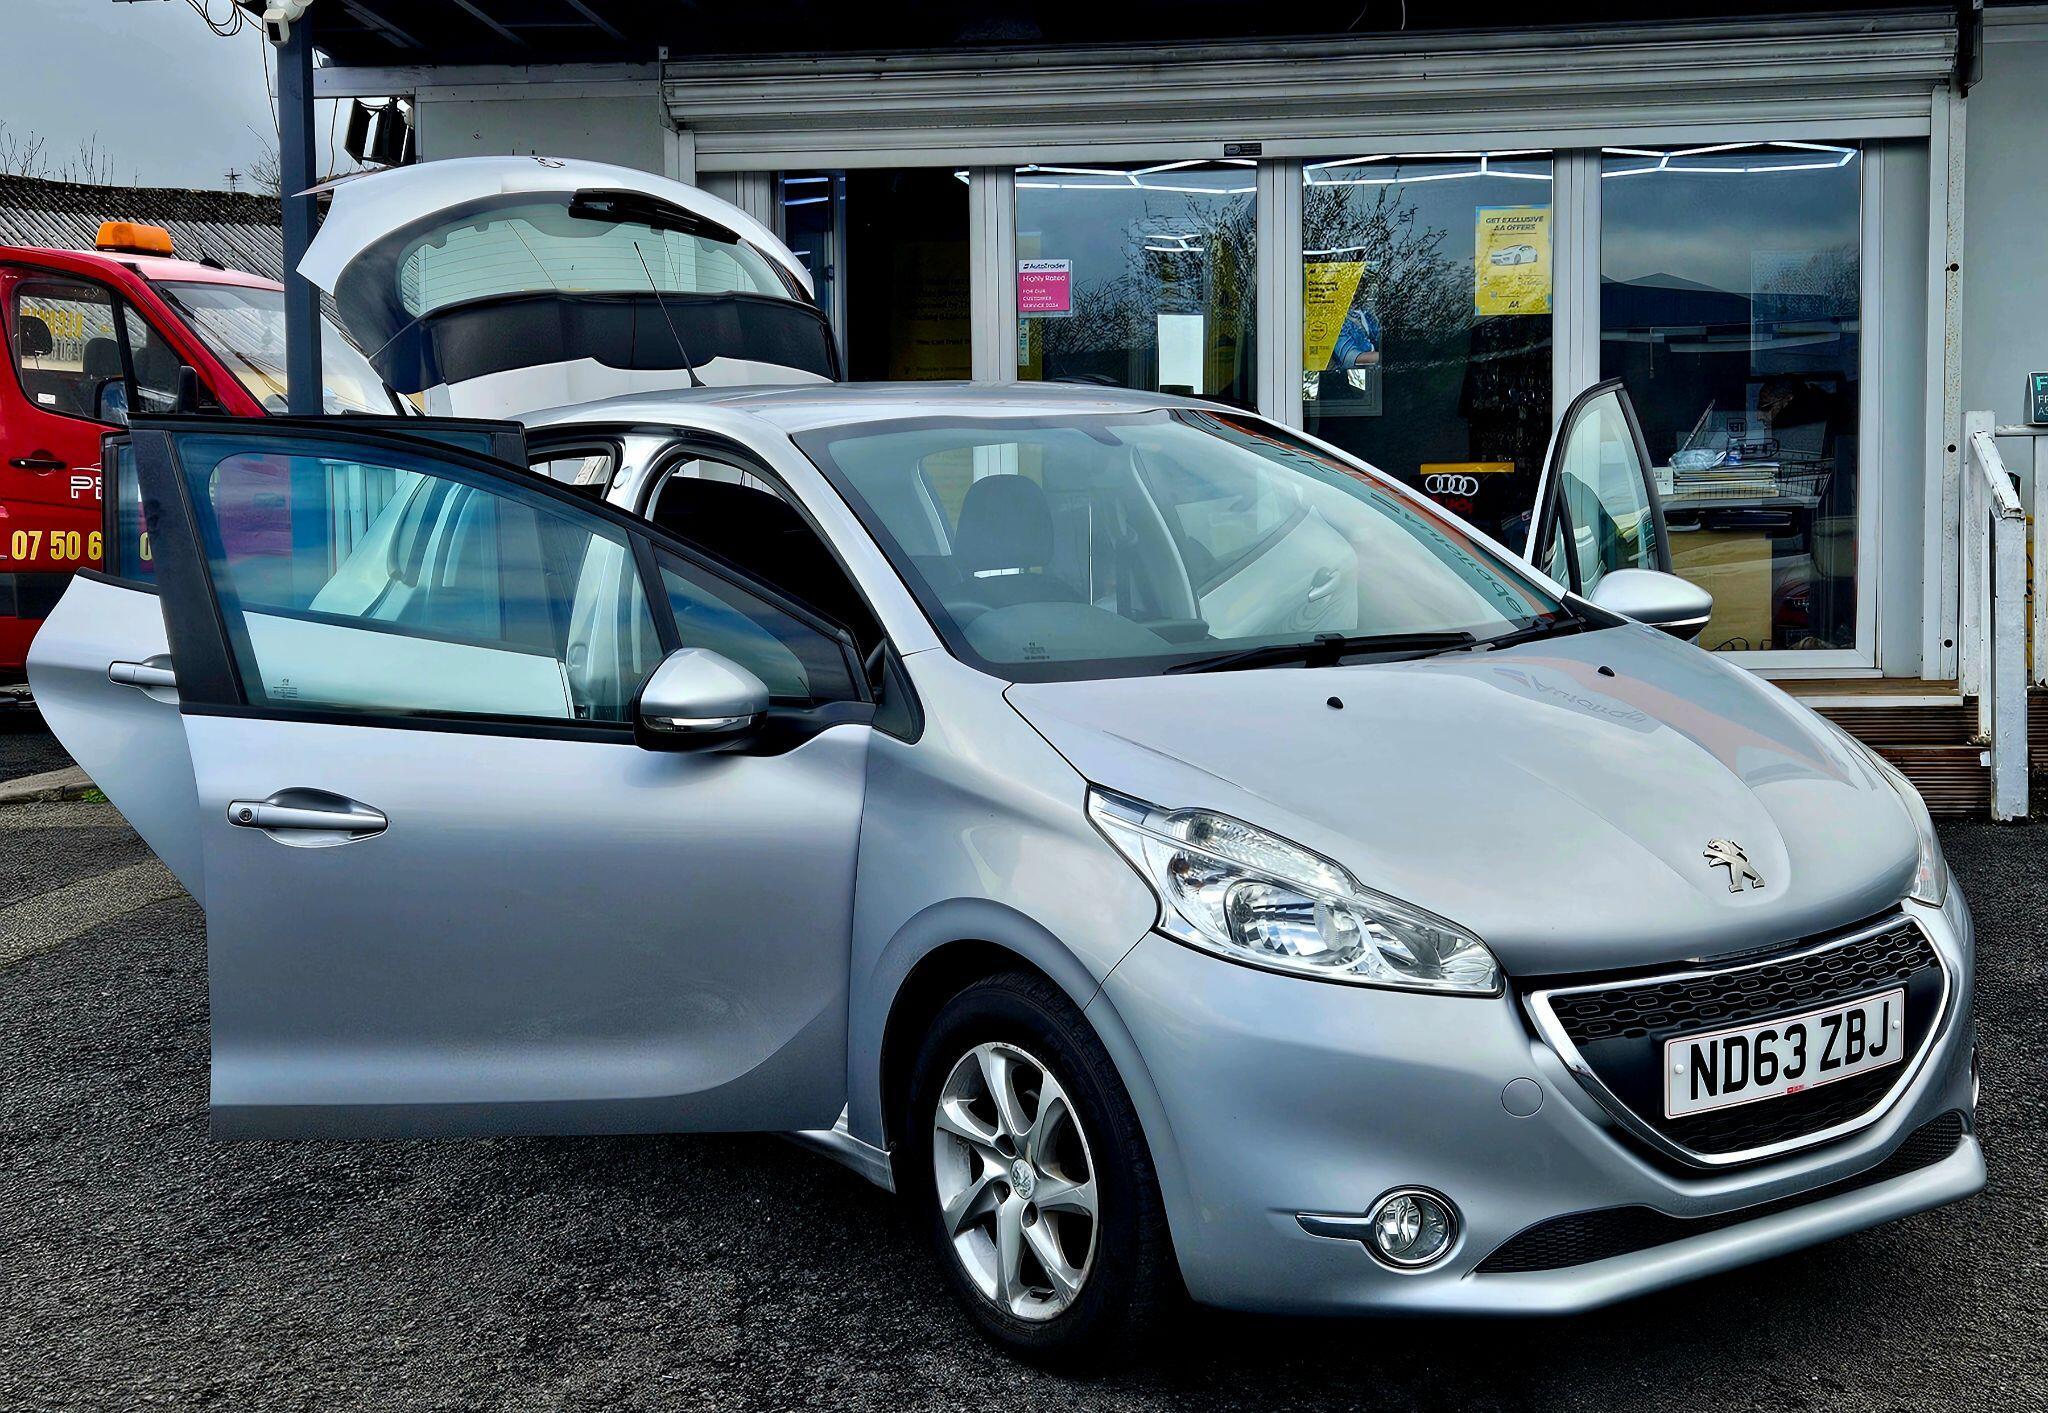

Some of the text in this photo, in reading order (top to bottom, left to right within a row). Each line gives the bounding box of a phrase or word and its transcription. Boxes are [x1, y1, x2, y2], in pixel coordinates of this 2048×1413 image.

[1502, 215, 1544, 223] EXCLUSIVE
[1022, 275, 1044, 283] Highly
[12, 530, 43, 561] 07
[50, 530, 81, 561] 50
[1690, 1001, 1889, 1100] ND63 ZBJ
